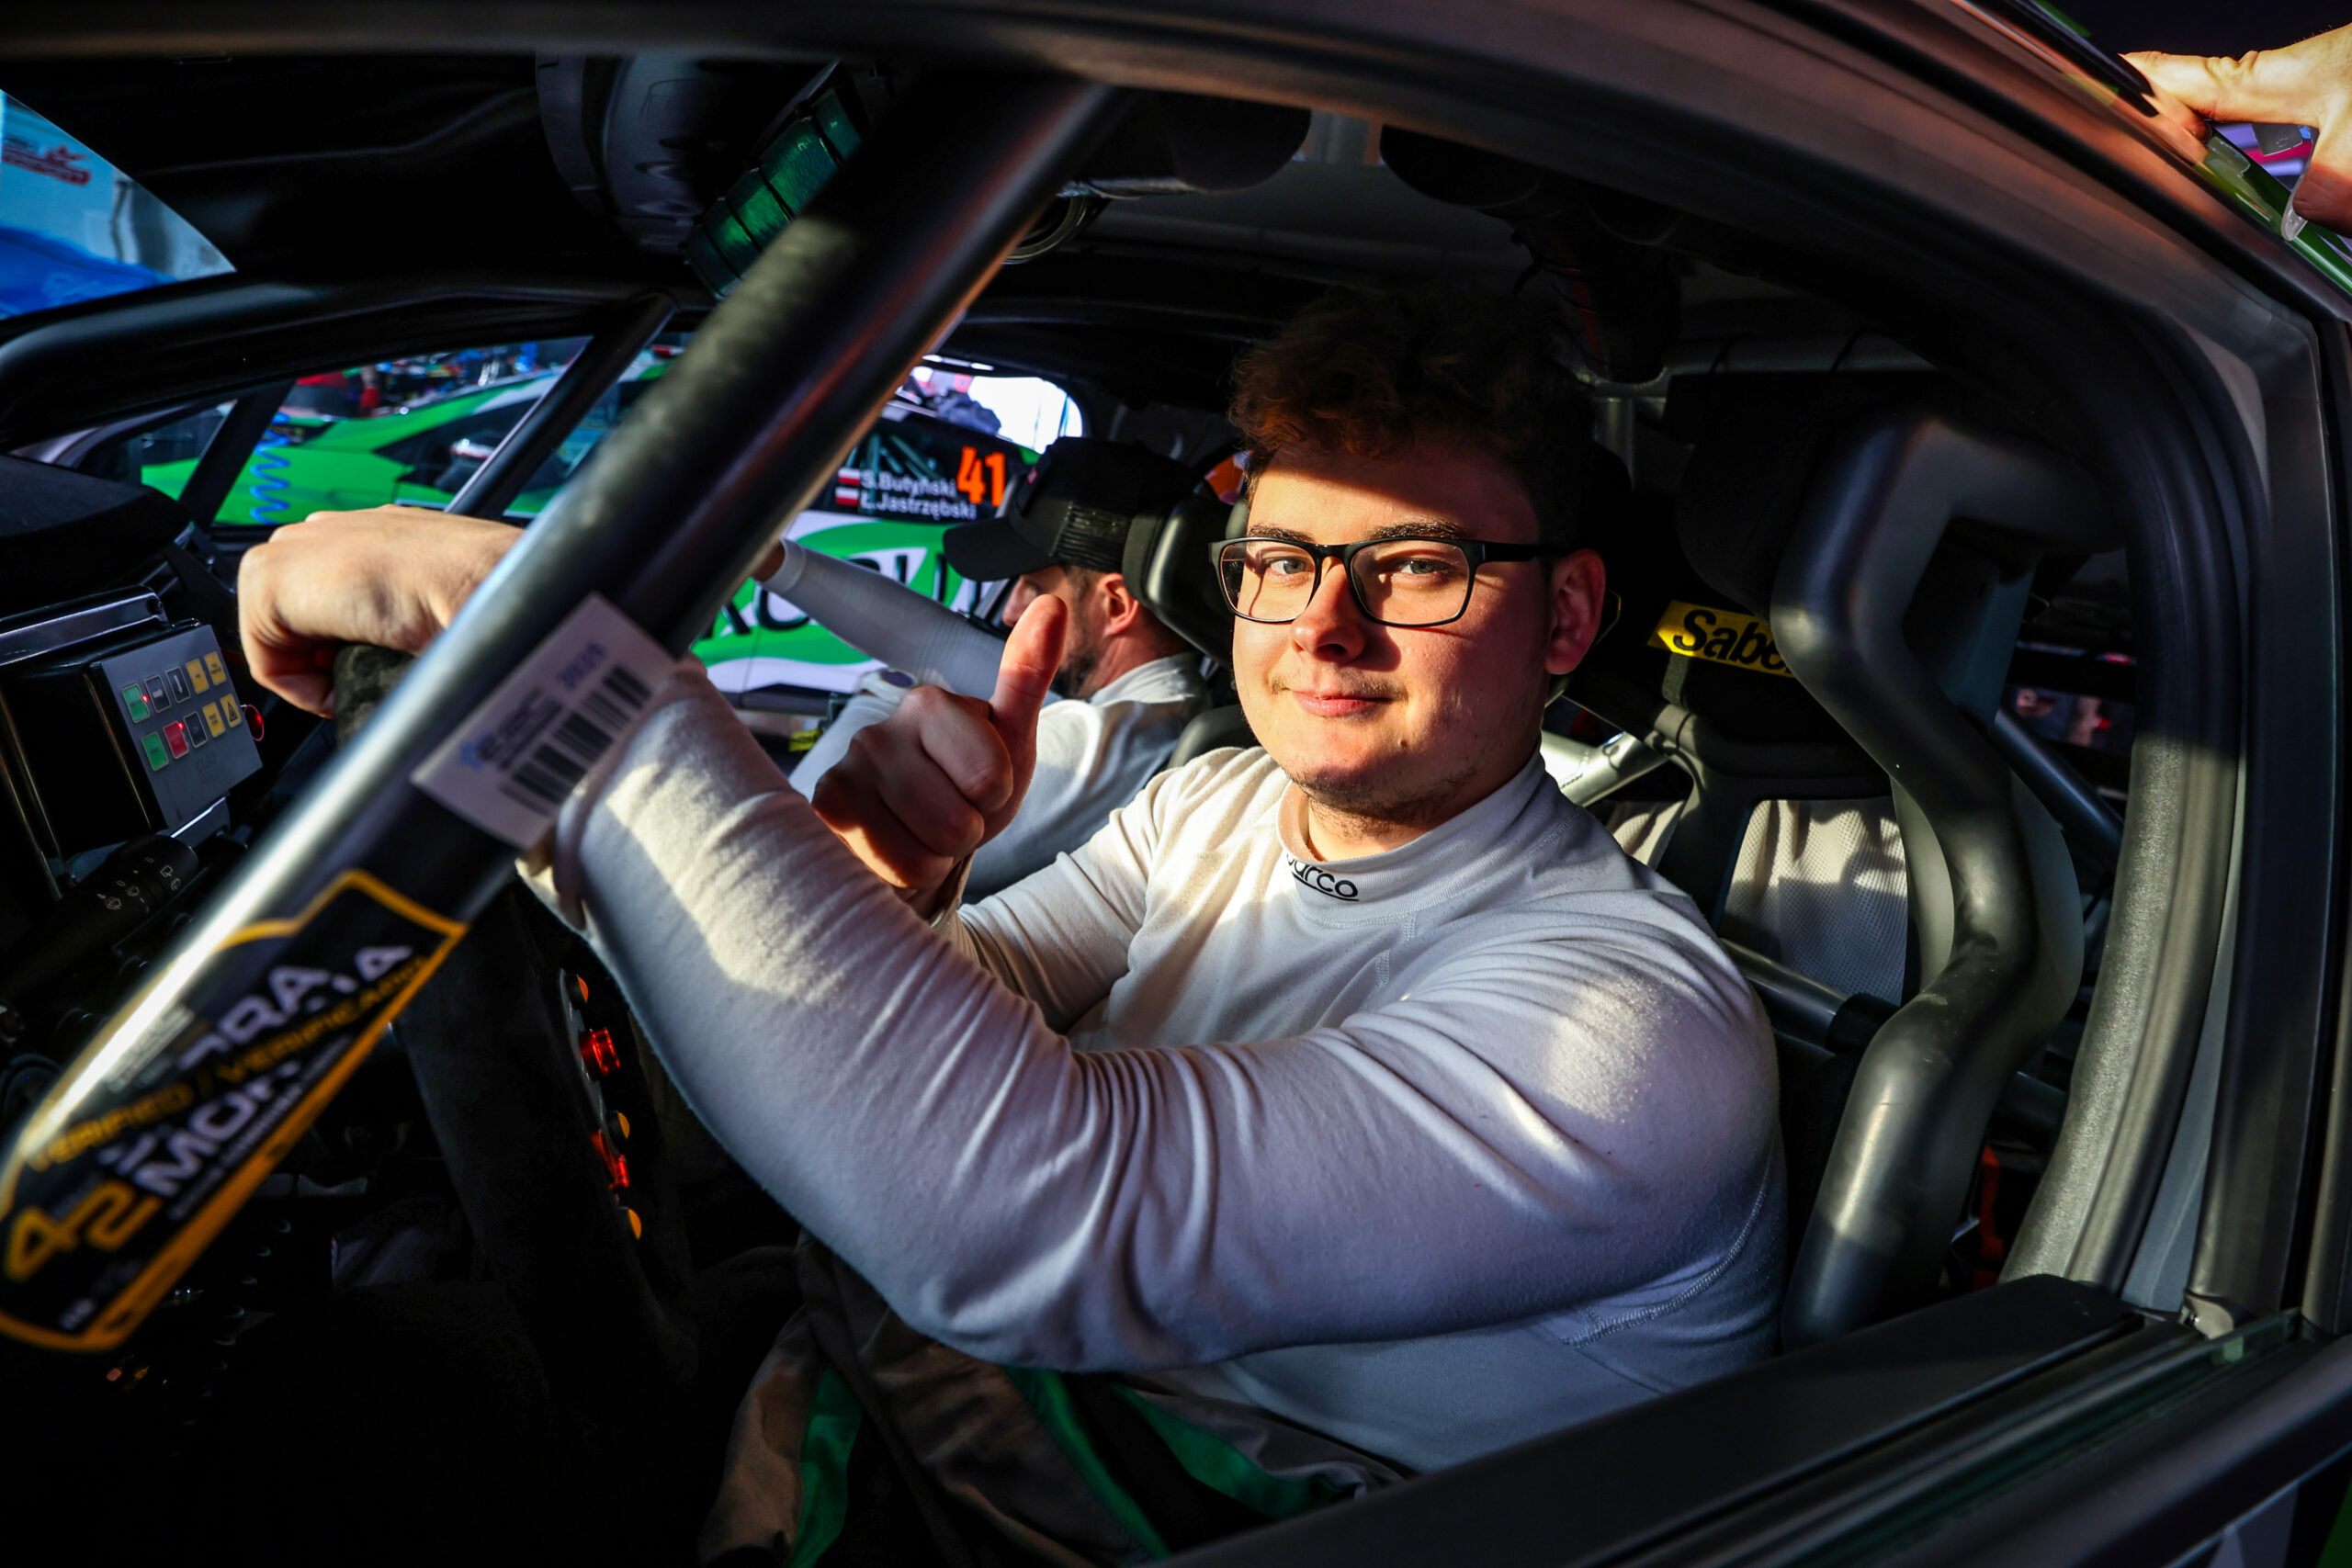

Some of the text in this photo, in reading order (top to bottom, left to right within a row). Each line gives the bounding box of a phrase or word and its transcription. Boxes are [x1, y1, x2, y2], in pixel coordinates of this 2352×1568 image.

[956, 446, 1006, 507] 41
[1673, 609, 1792, 674] Sabe
[4, 1178, 163, 1280] 42
